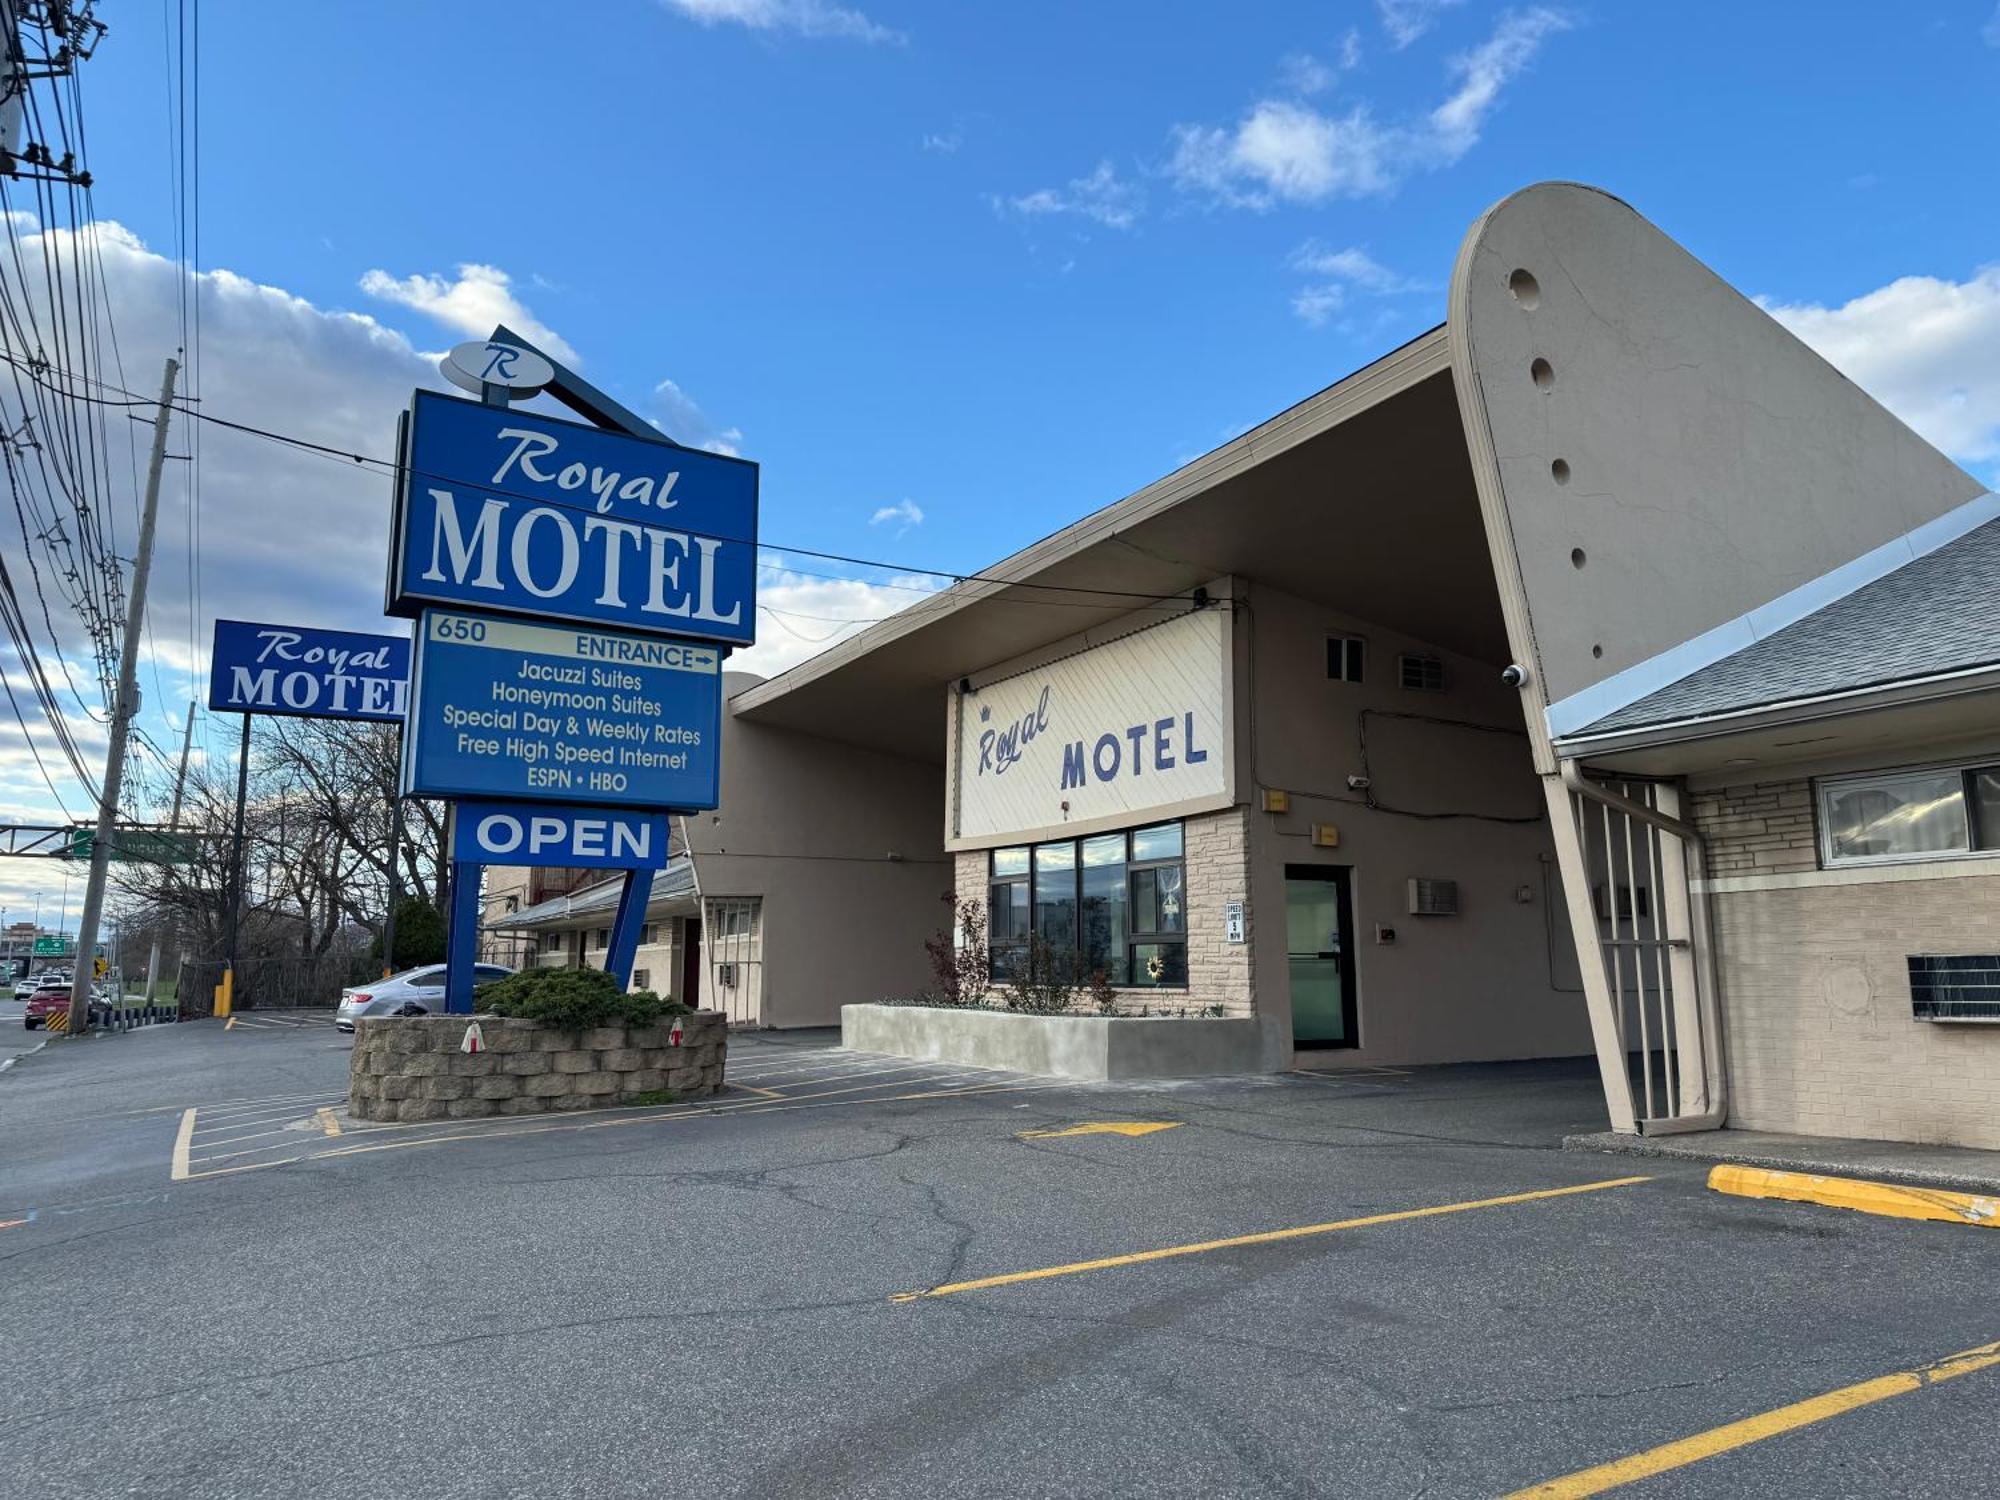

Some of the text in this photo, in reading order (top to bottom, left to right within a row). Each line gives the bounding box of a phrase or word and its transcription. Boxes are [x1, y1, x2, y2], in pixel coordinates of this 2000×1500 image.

[481, 344, 518, 380] R
[492, 427, 680, 514] Royal
[422, 487, 741, 625] MOTEL
[256, 630, 390, 676] Royal
[437, 617, 693, 668] 650 ENTRANCE
[518, 660, 641, 690] Jacuzzi Suites
[492, 682, 661, 716] Honeymoon Suites
[443, 705, 701, 745] Special Day & Weekly Rates
[978, 684, 1050, 776] Royal
[458, 733, 687, 769] Free High Speed Internet
[1061, 711, 1207, 790] MOTEL
[527, 768, 627, 792] ESPN HBO
[476, 814, 650, 858] OPEN
